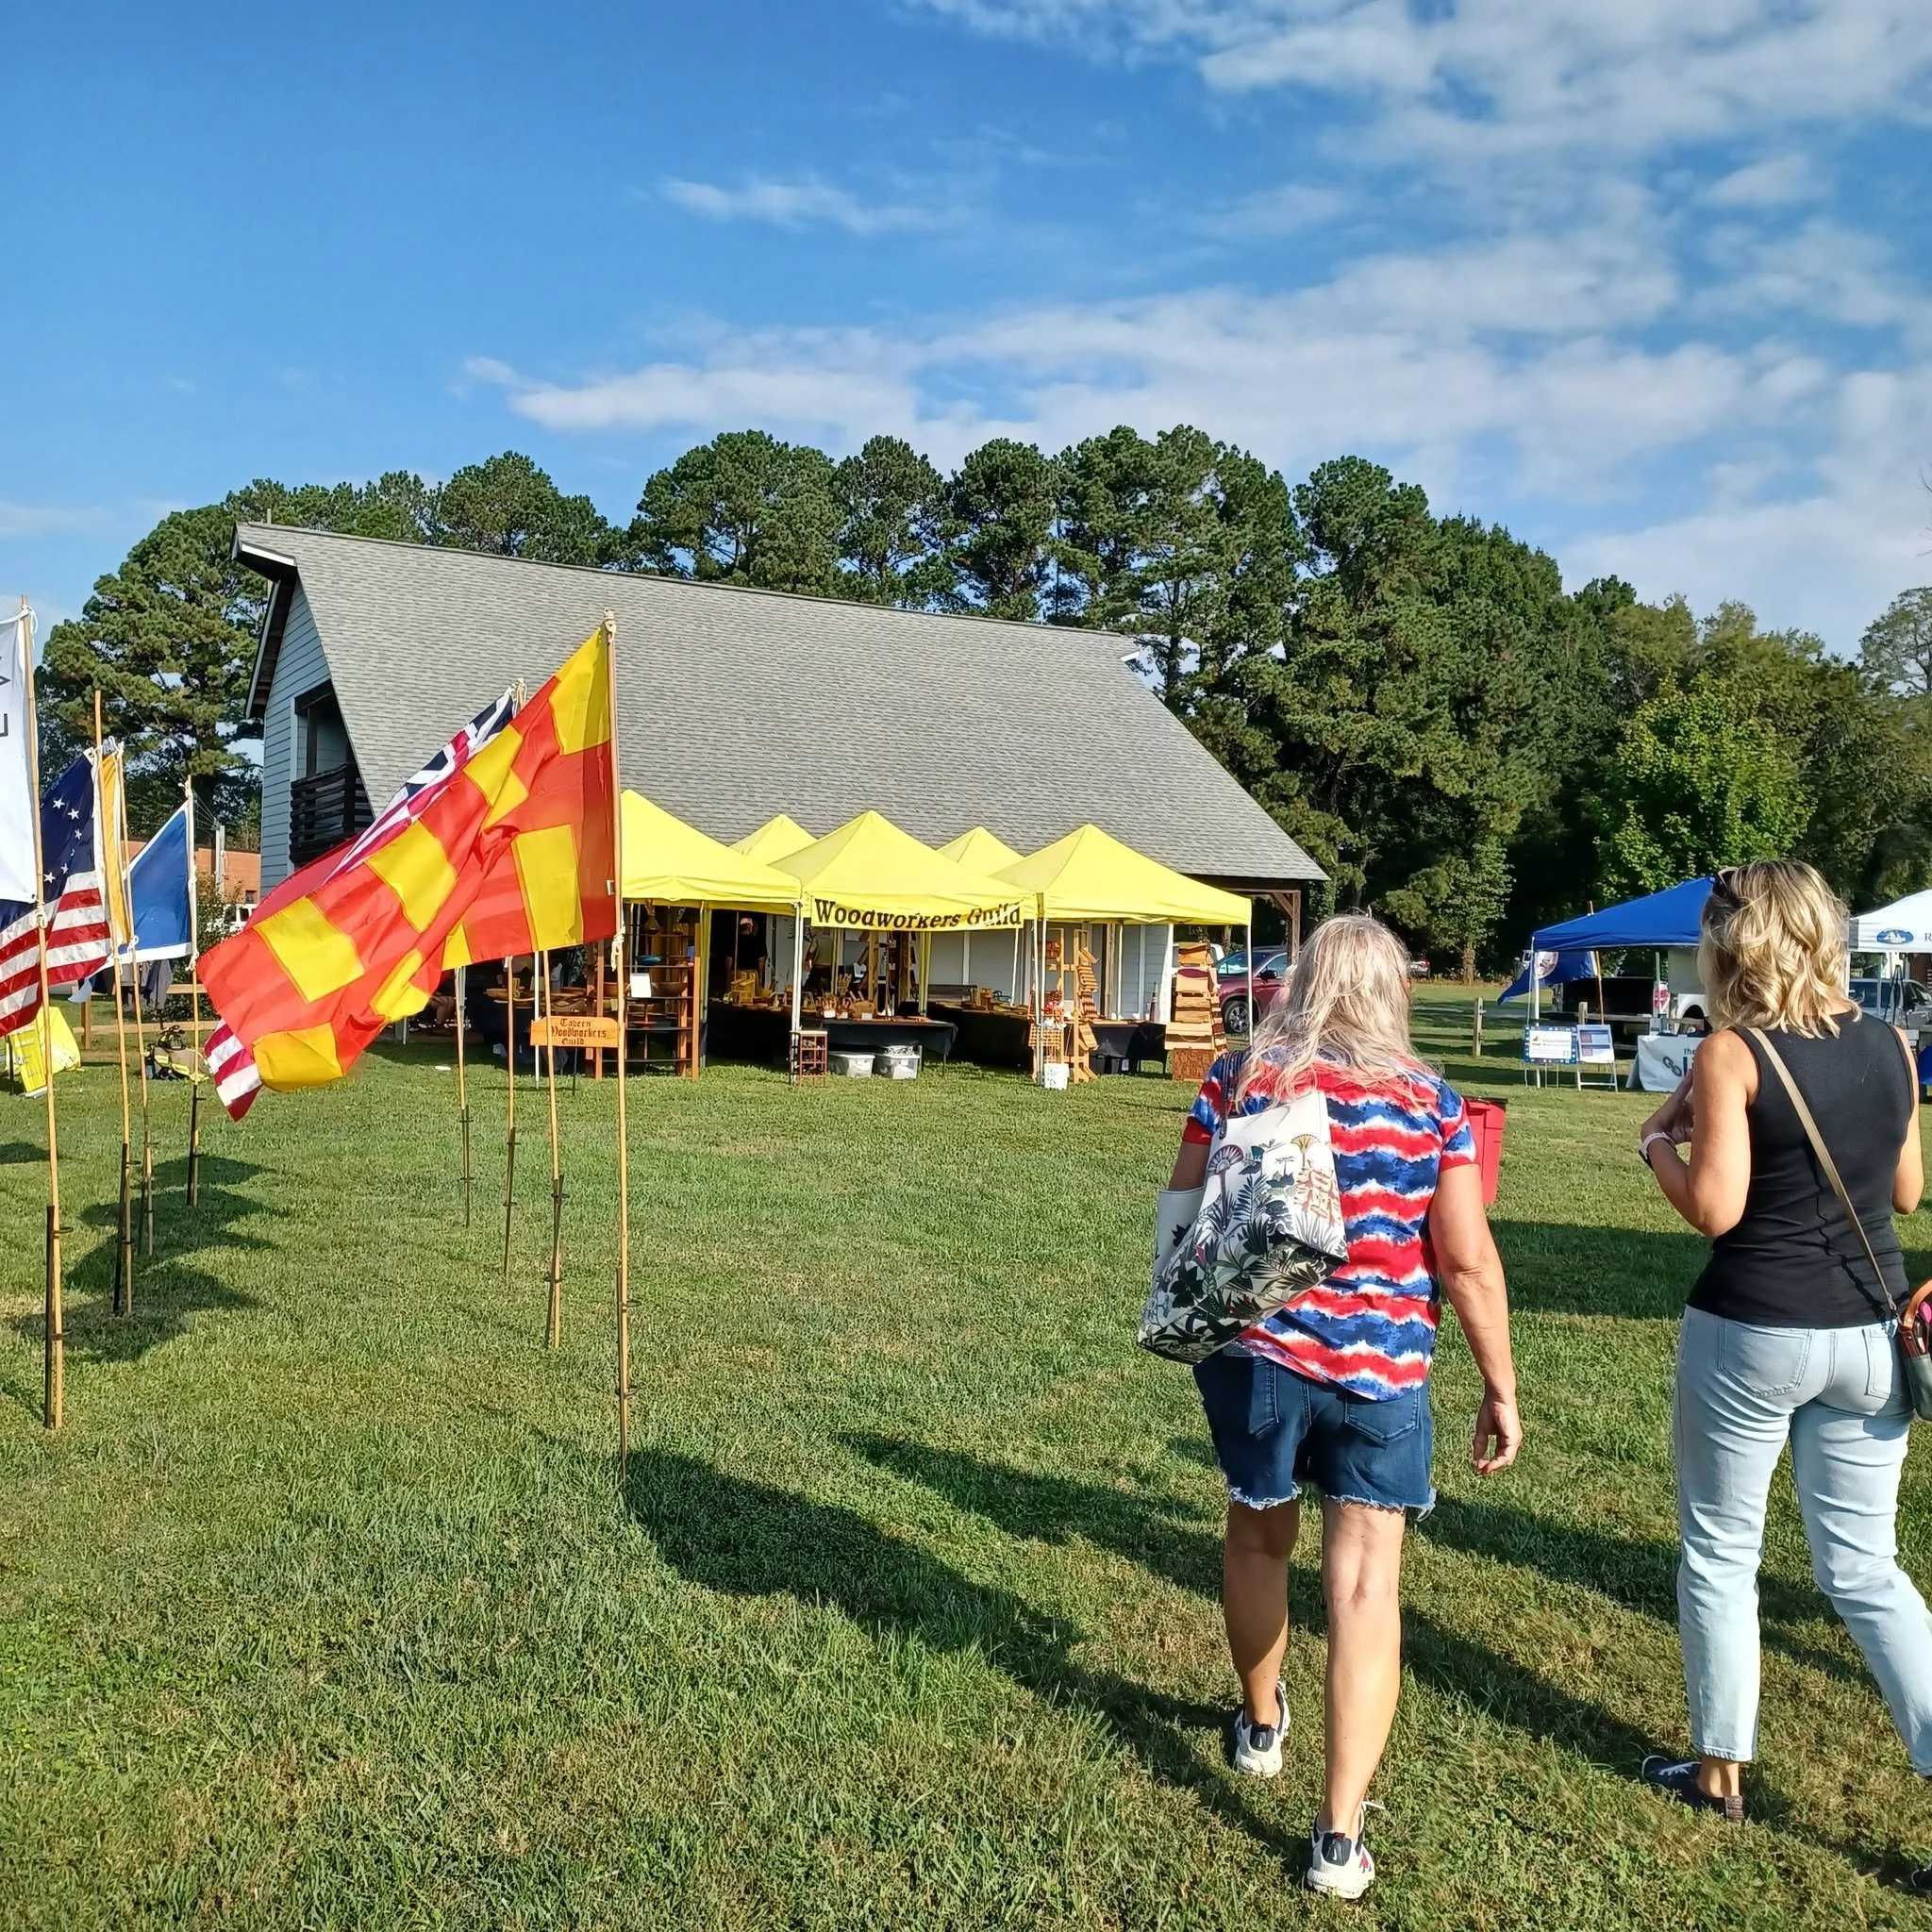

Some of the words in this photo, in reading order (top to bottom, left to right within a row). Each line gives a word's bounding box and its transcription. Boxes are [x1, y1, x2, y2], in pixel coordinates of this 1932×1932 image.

[814, 898, 961, 929] Woodworkers
[967, 903, 1022, 926] Guild
[559, 1018, 591, 1027] Tavern
[561, 1037, 585, 1045] Guild
